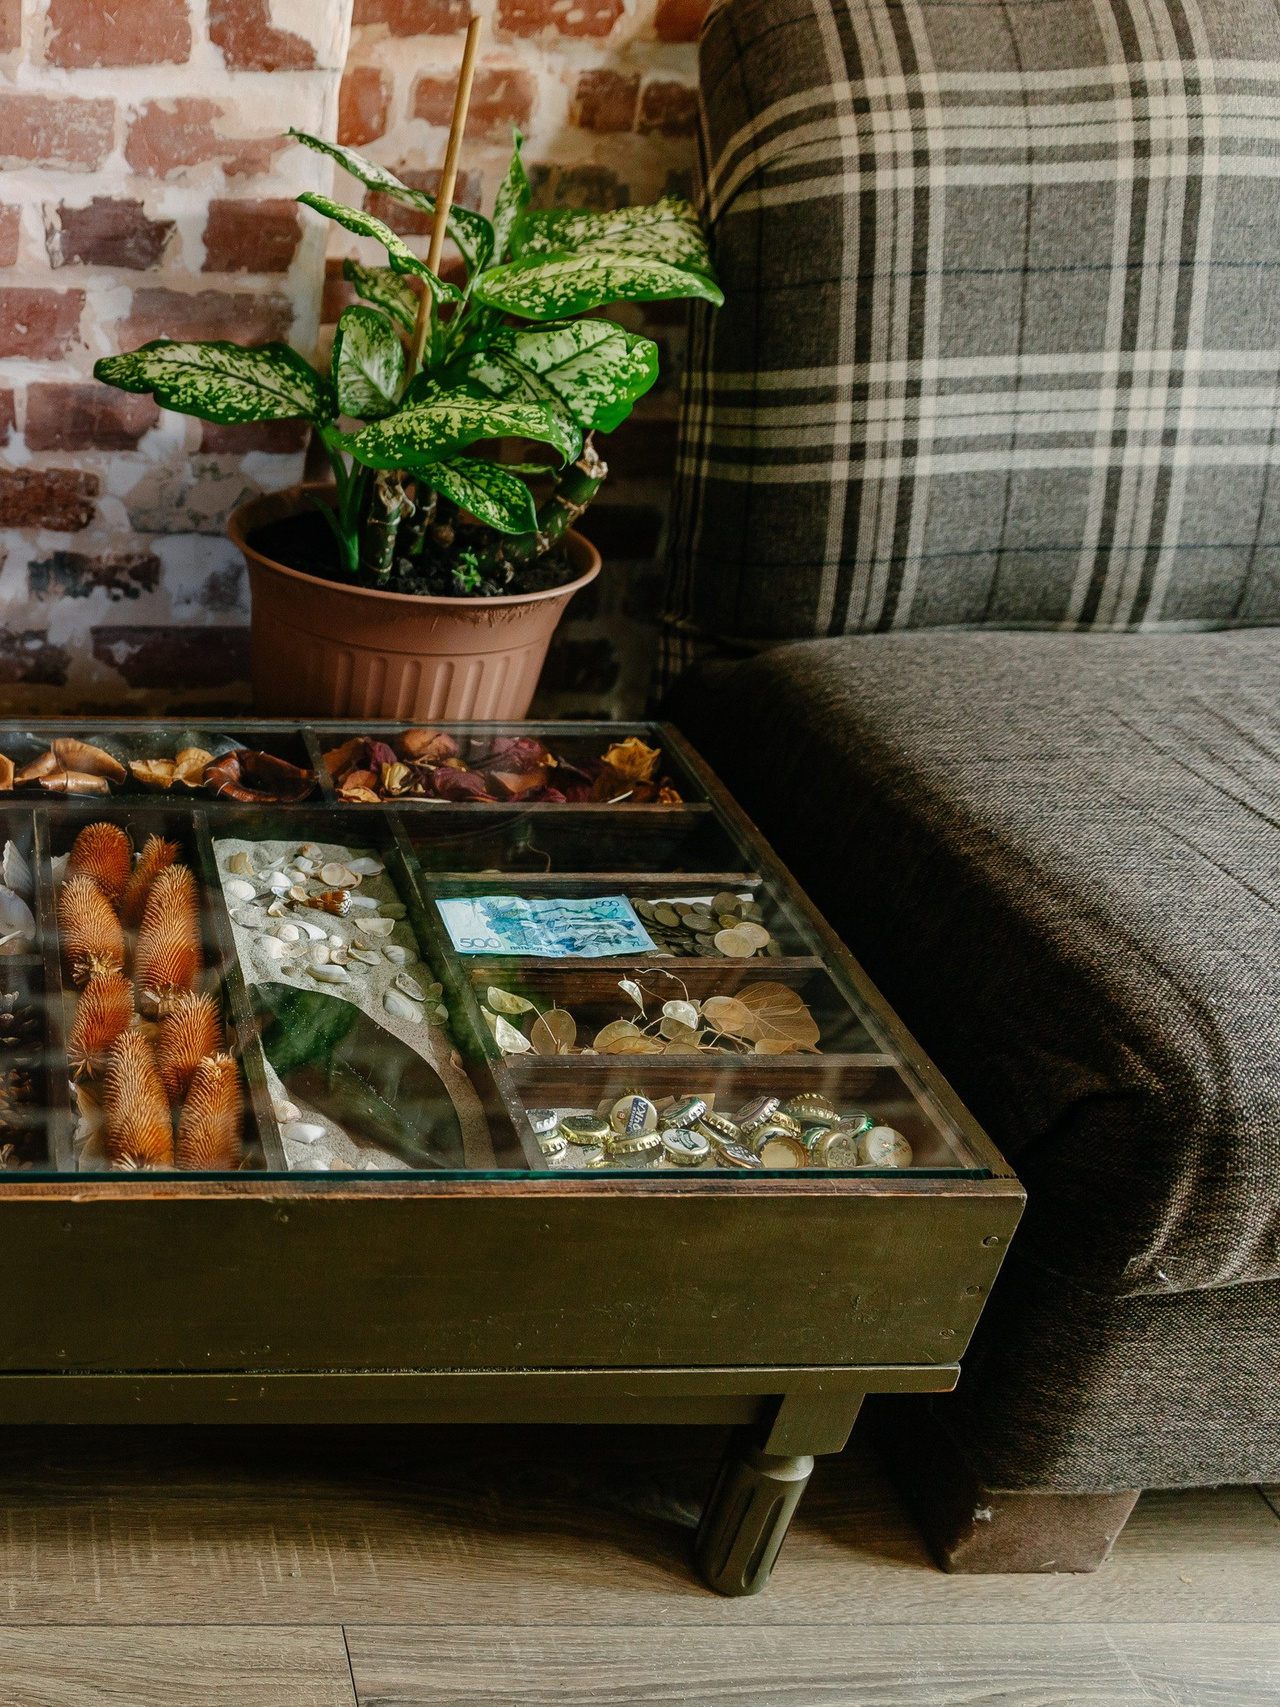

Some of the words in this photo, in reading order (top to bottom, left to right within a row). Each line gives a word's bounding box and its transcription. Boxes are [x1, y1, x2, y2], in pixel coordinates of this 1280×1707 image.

[595, 900, 620, 908] 500
[459, 937, 502, 949] 500
[628, 1100, 650, 1131] ОЧКА
